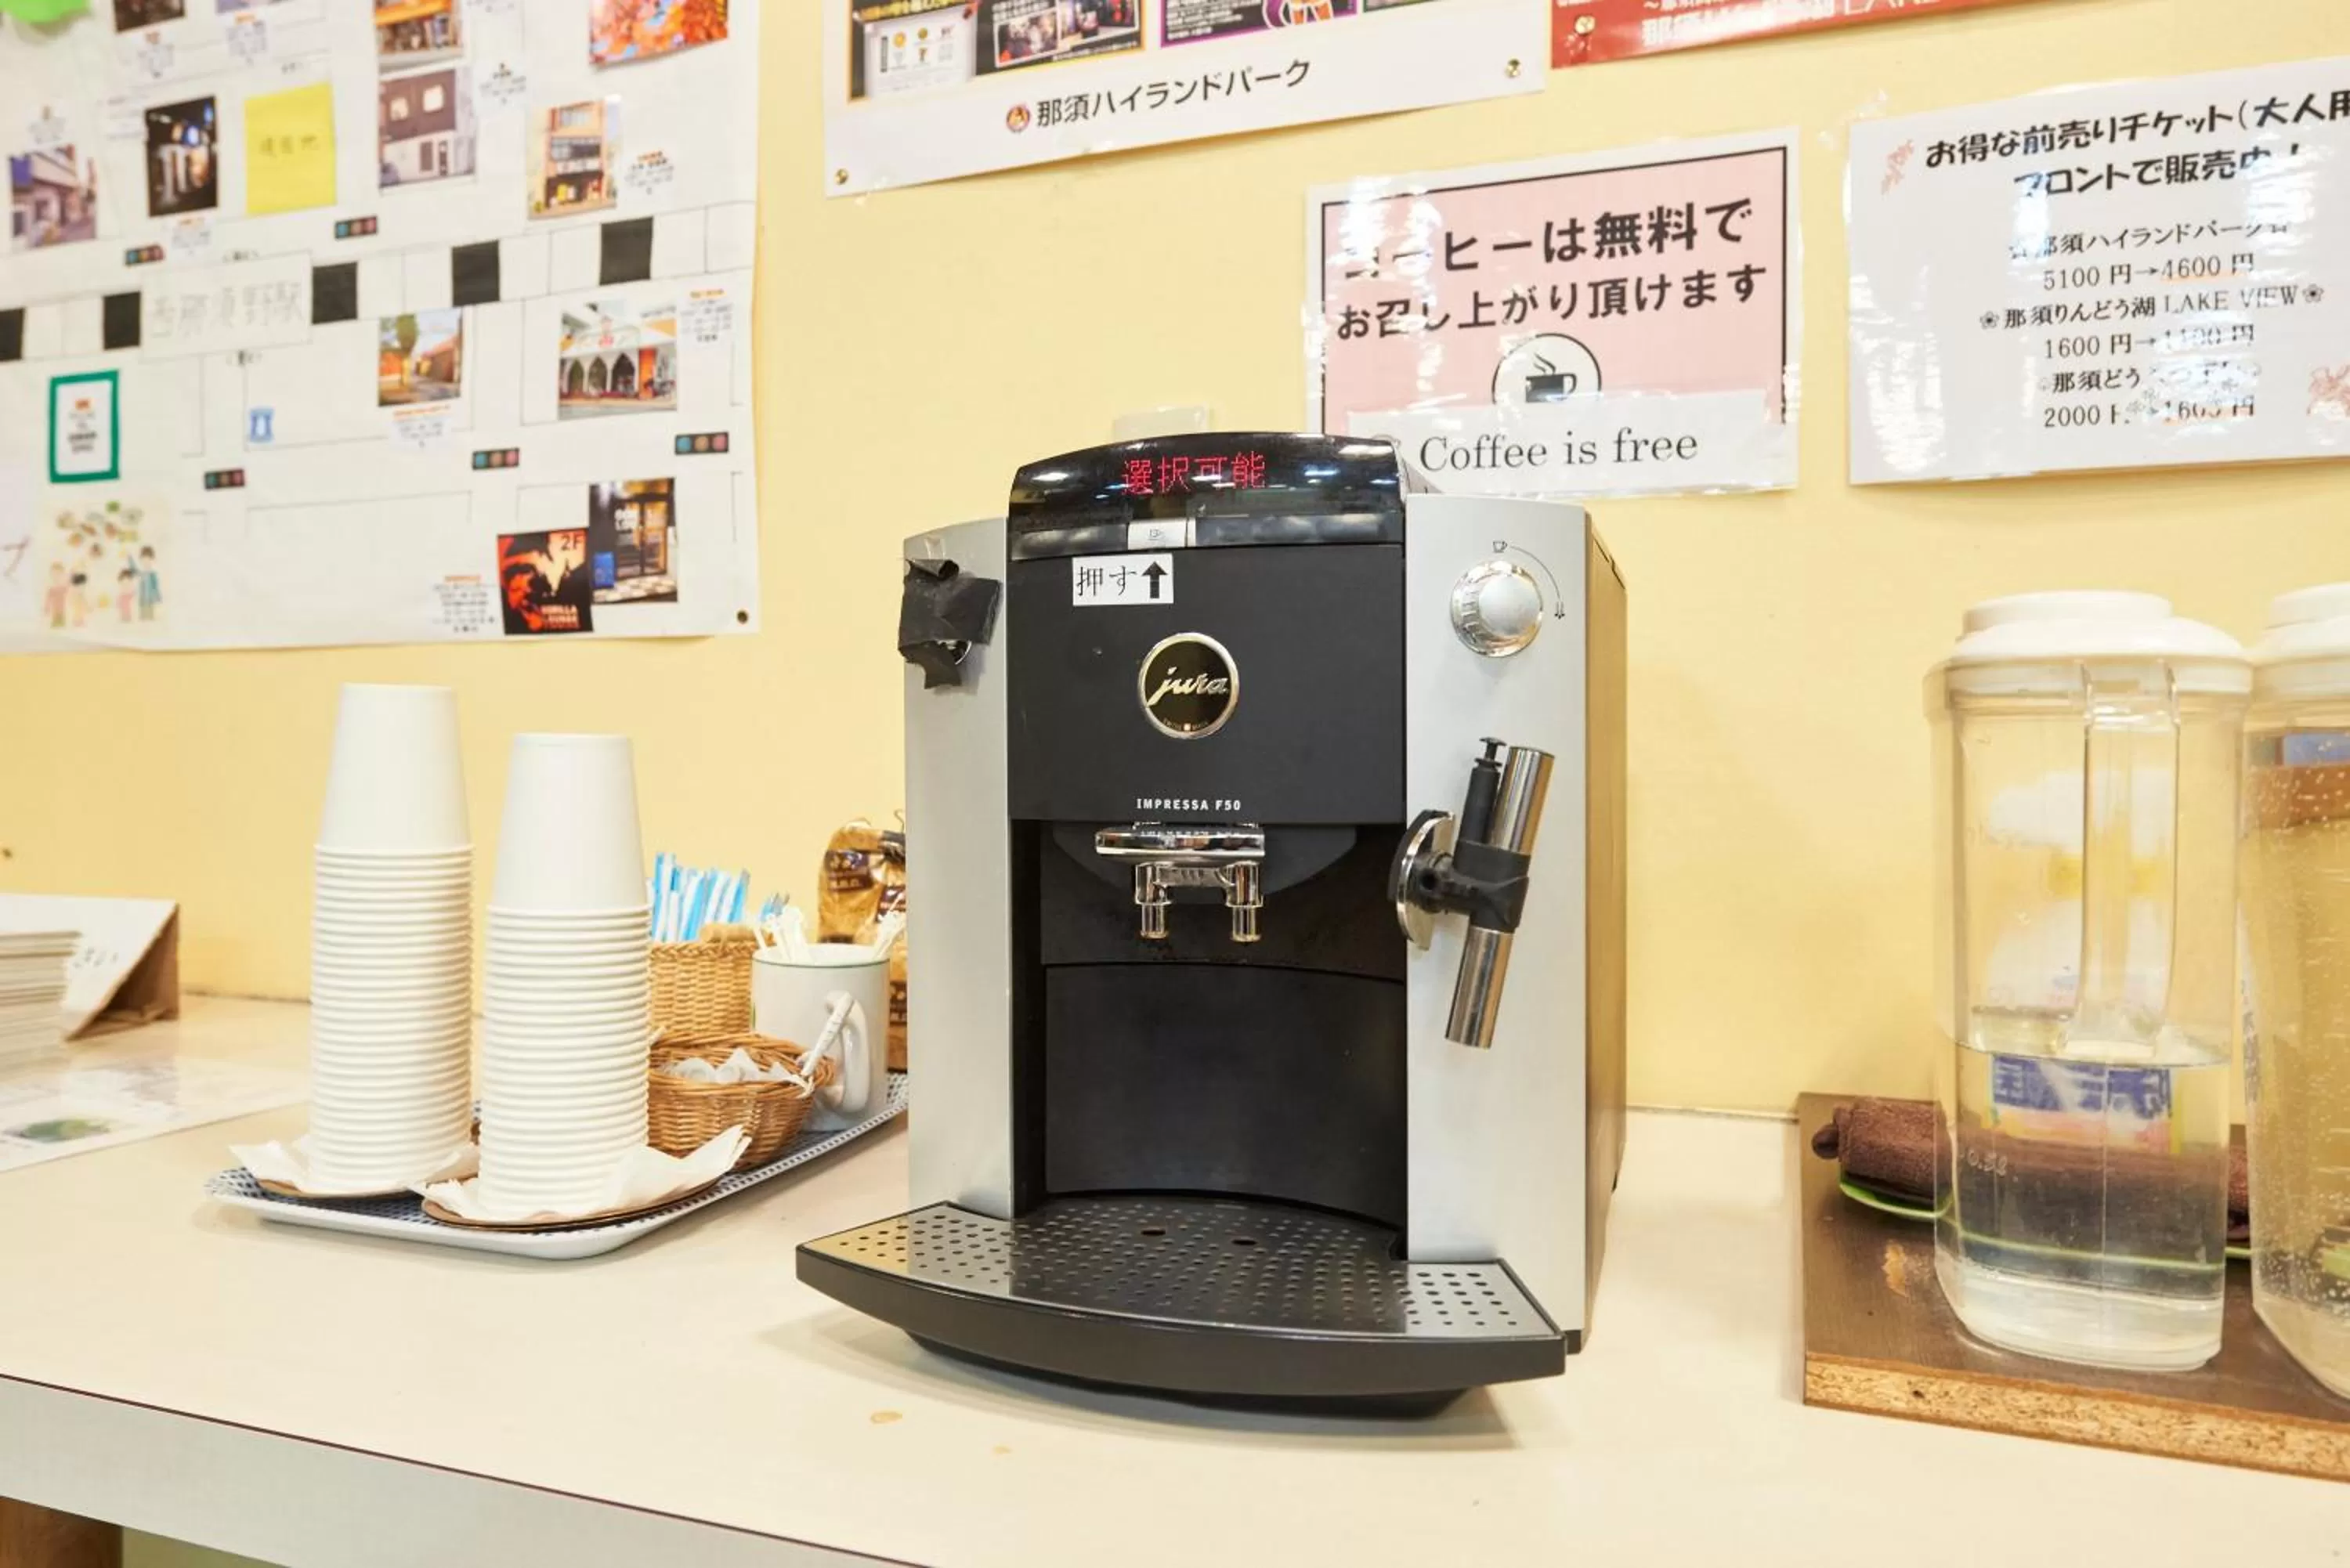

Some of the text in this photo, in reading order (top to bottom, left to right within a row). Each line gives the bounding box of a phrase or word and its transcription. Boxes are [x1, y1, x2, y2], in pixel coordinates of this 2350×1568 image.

[1036, 60, 1311, 128] 那須ハイランドパーク
[1336, 263, 1767, 340] お召し上がり頂けます
[2004, 296, 2157, 330] 那須りんどう湖
[1419, 425, 1698, 472] Coffee is free
[1121, 451, 1267, 496] 選択可能
[1076, 565, 1138, 598] 押す
[1146, 666, 1230, 707] jura
[1136, 797, 1242, 811] IMPRESSA F50
